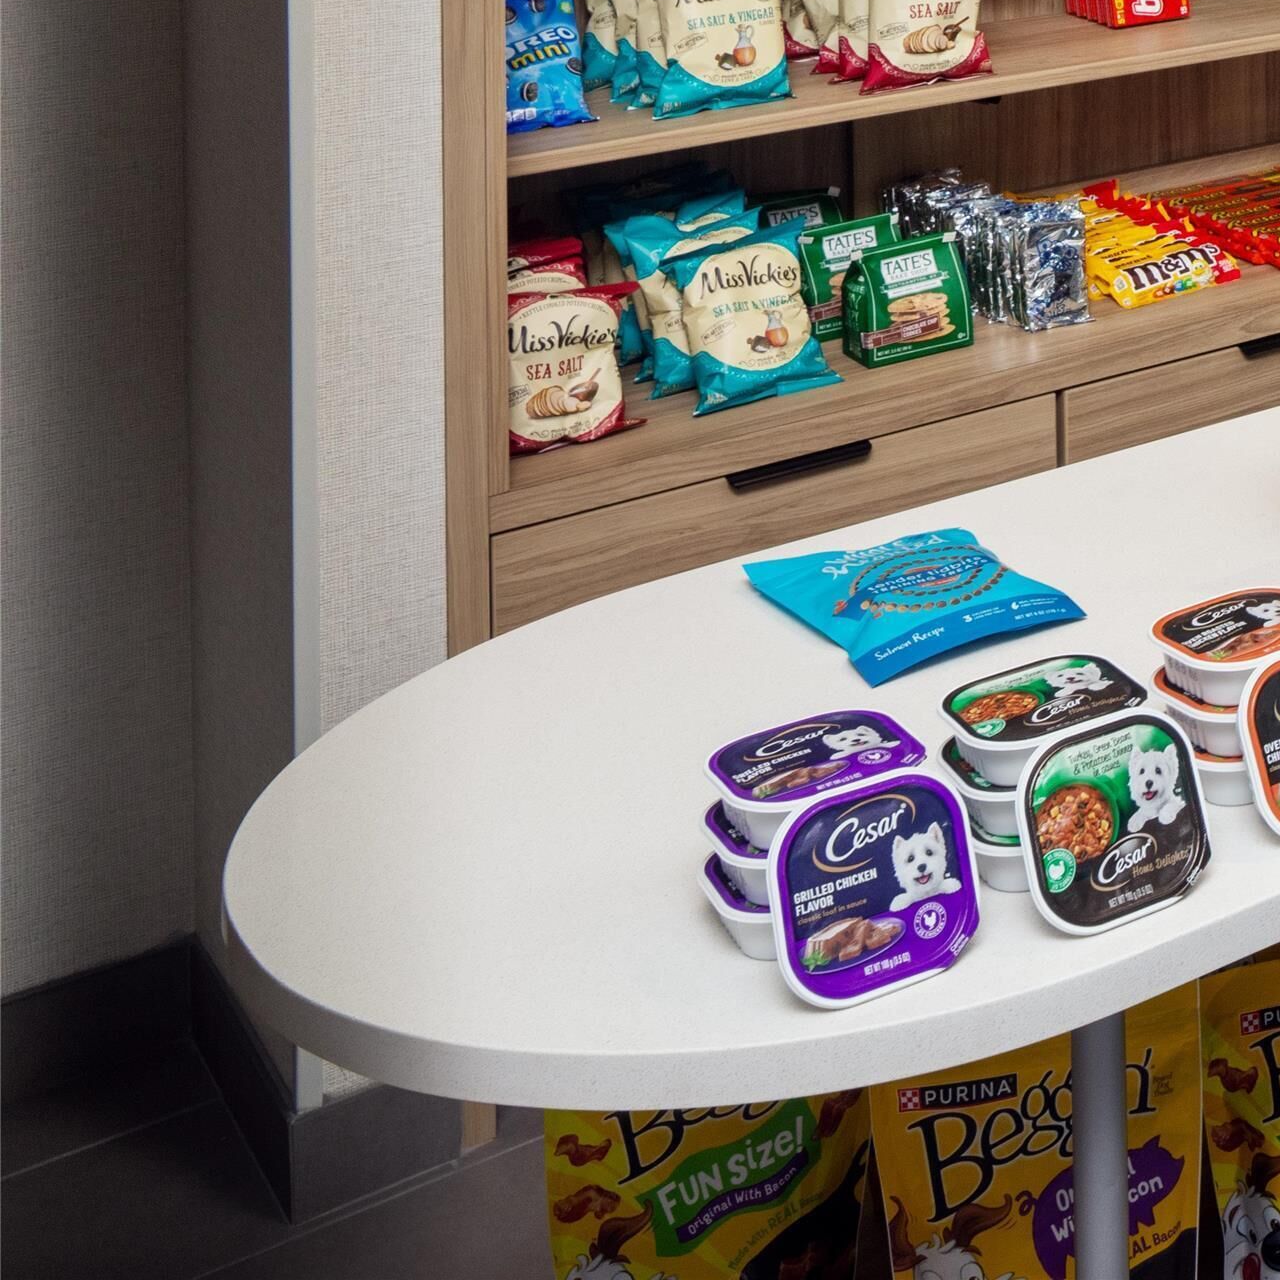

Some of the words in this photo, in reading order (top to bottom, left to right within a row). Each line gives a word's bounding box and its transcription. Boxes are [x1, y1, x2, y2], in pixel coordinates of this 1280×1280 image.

[687, 16, 705, 30] SEA
[706, 14, 727, 28] SALT
[729, 12, 736, 24] &
[909, 6, 933, 18] SEA
[936, 1, 961, 17] SALT
[509, 39, 570, 71] mini
[526, 364, 553, 381] SEA
[557, 356, 584, 377] SALT
[874, 638, 912, 662] Salmon
[912, 625, 946, 646] Recipe
[825, 803, 907, 863] Cesar
[793, 883, 835, 905] GRILLED
[835, 868, 878, 889] CHICKEN
[795, 897, 835, 917] FLAVOR
[923, 1079, 1012, 1106] PURINA
